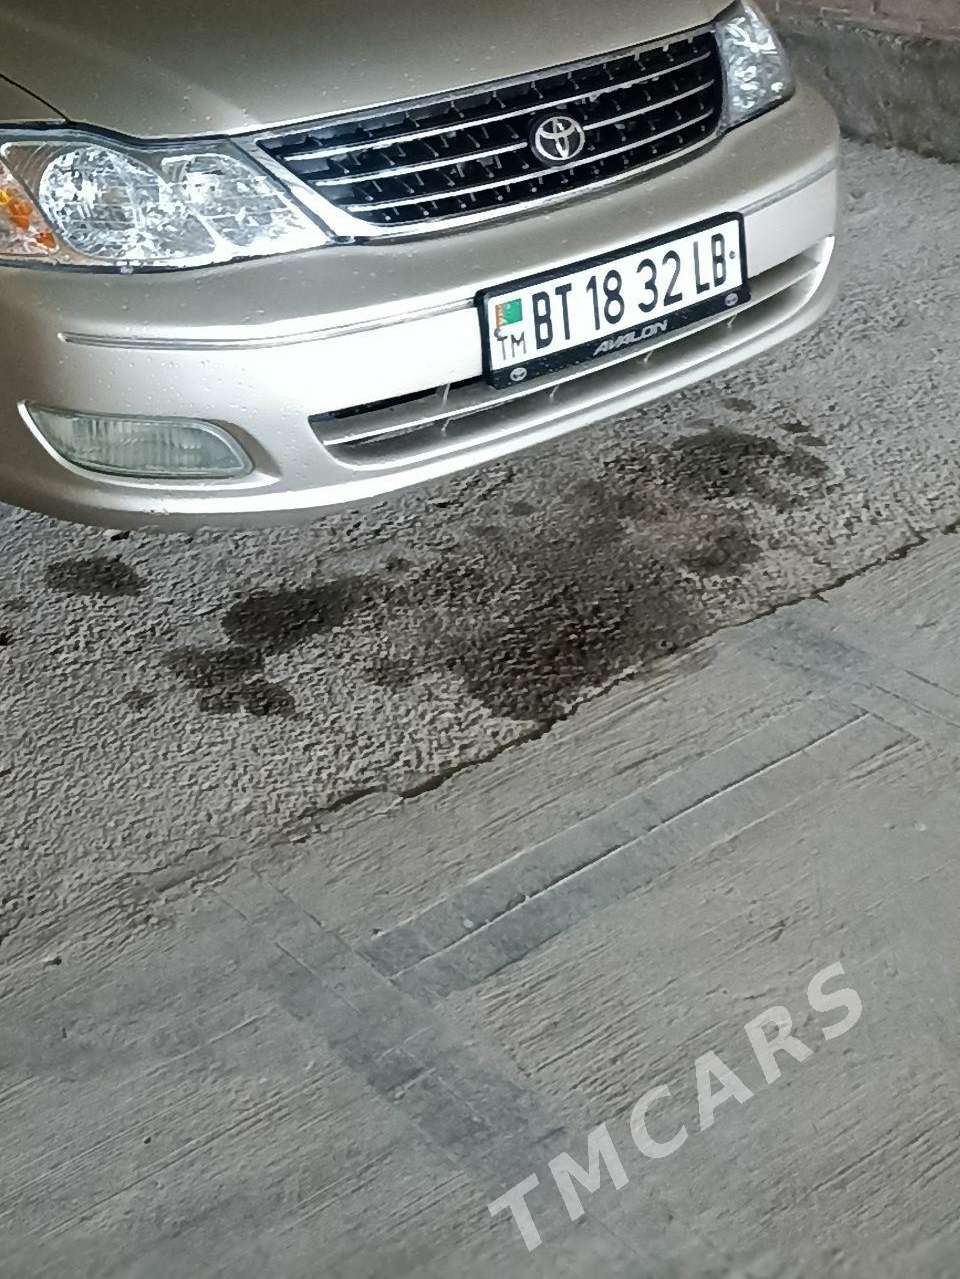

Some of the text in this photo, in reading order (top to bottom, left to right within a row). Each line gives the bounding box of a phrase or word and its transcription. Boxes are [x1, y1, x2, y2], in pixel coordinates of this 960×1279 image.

[531, 233, 727, 350] BT 18 32 LB
[497, 331, 527, 361] TM
[592, 319, 668, 357] AVALON
